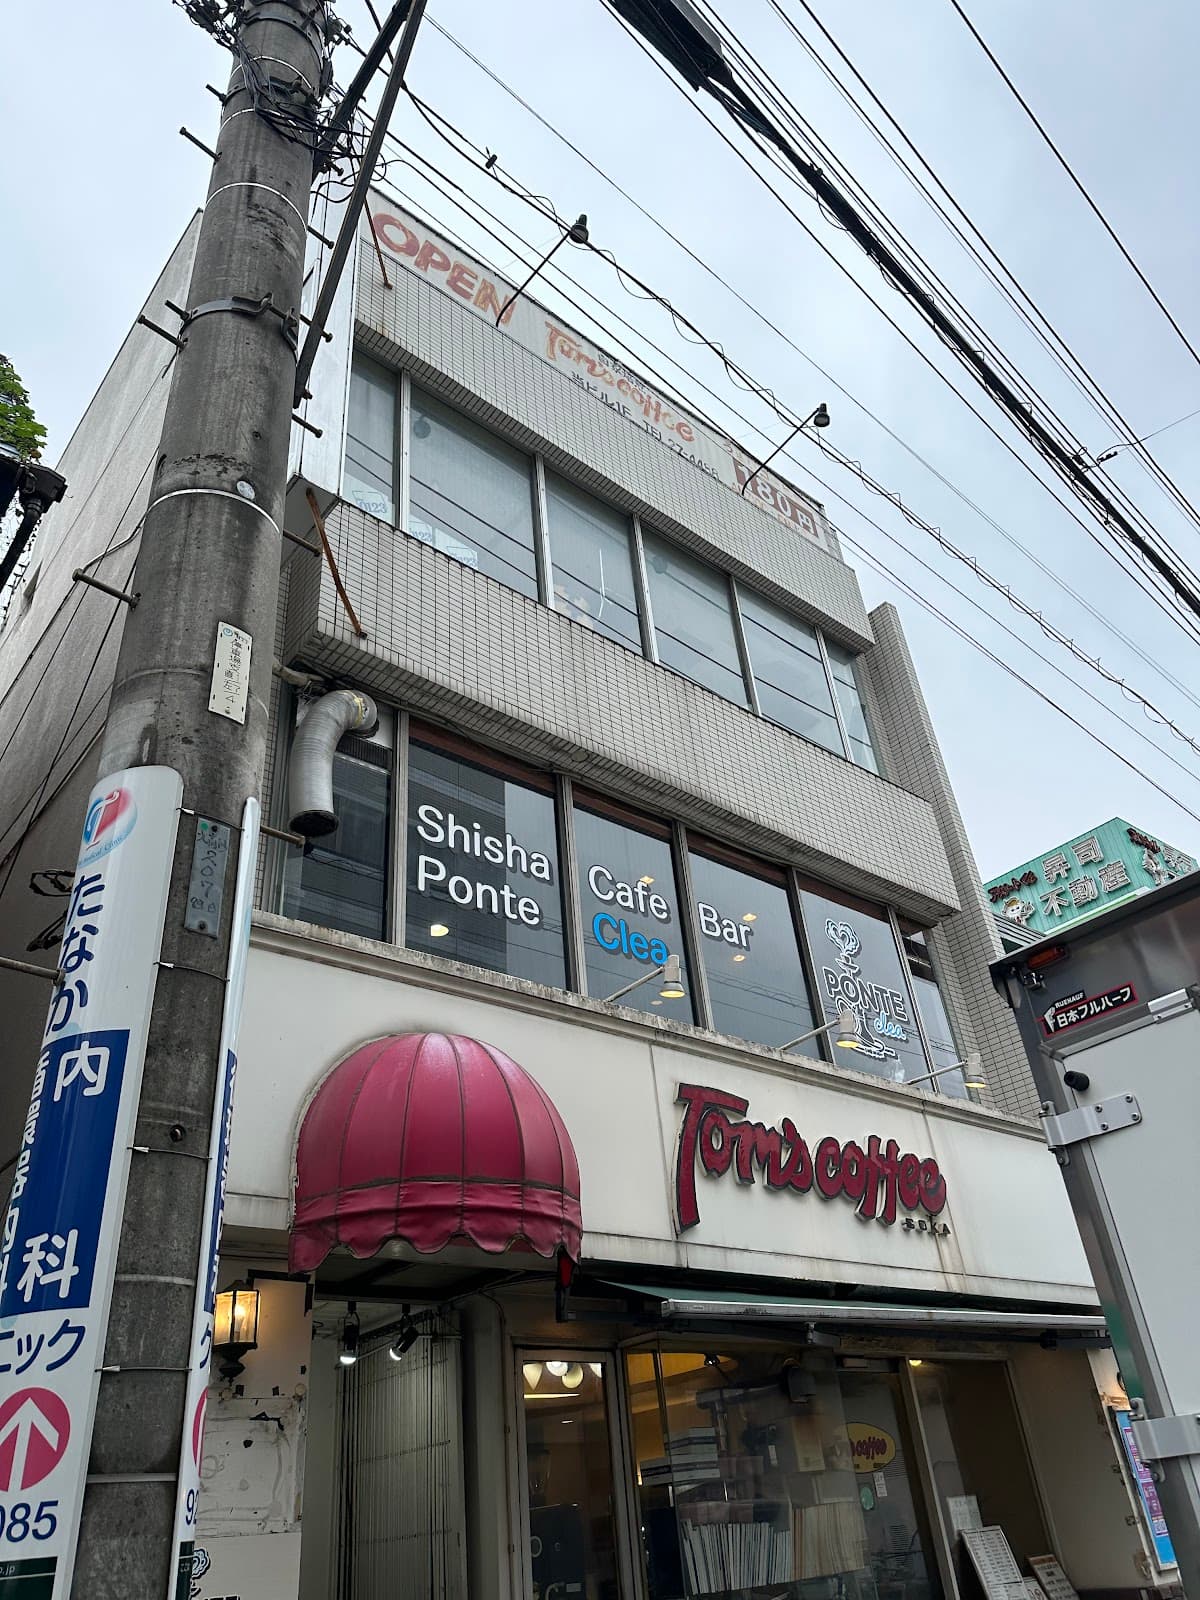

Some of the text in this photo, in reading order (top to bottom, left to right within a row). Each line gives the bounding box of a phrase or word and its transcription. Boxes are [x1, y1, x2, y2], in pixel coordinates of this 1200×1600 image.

[372, 212, 517, 326] OPEN
[417, 805, 551, 882] Shisha
[417, 855, 541, 926] Ponte
[588, 865, 668, 920] Cafe
[46, 872, 105, 1037] たなか
[593, 913, 669, 966] Clea
[698, 903, 751, 947] Bar
[822, 966, 908, 1021] PONTE
[1055, 985, 1132, 1029] 日本フルハーフ
[17, 1041, 111, 1303] 内科
[813, 1134, 947, 1226] coffee
[902, 1216, 952, 1236] SOKA
